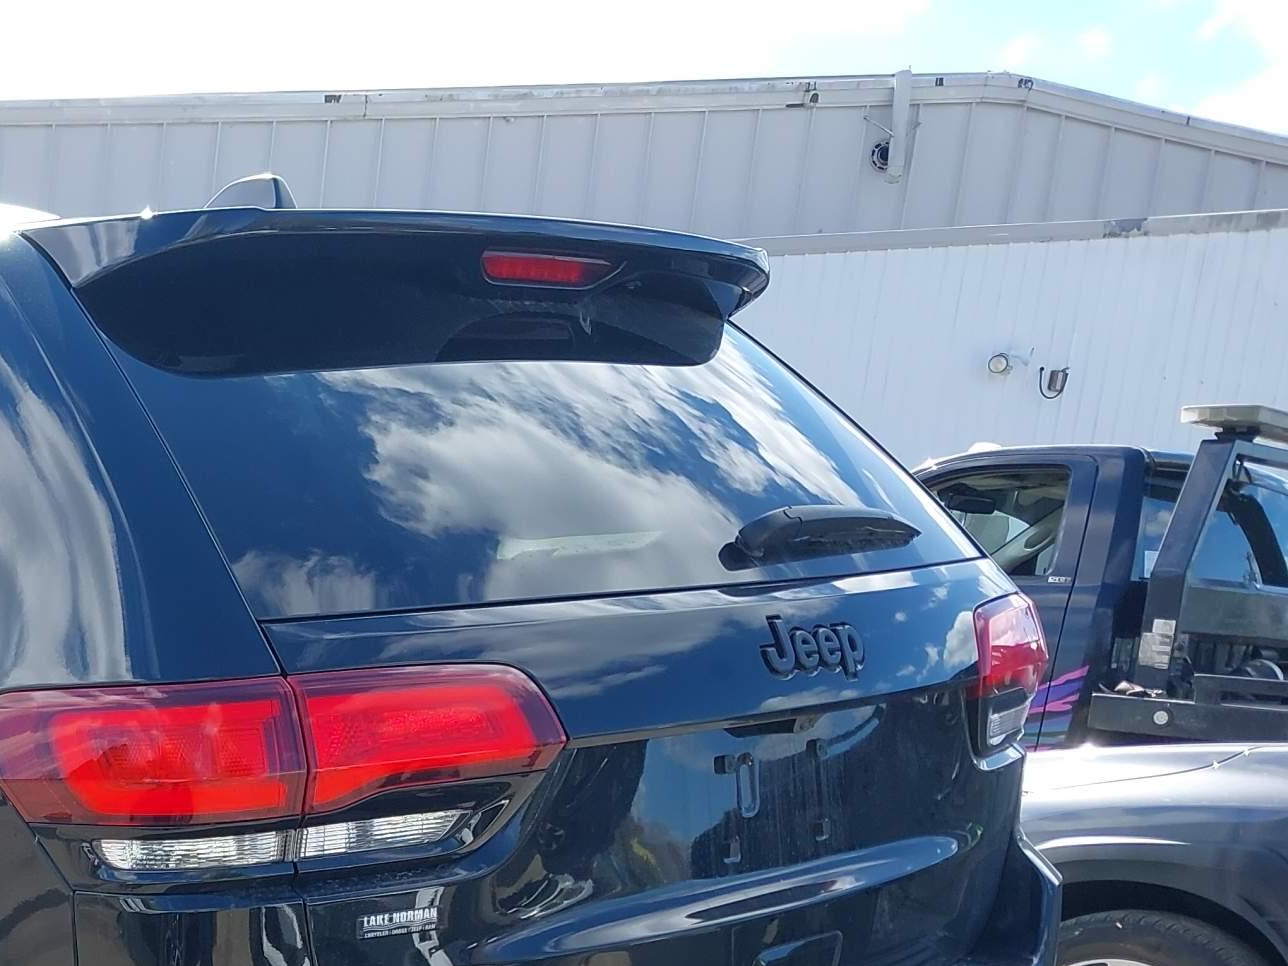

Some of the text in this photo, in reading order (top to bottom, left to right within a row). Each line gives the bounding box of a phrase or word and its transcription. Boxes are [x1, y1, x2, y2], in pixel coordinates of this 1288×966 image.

[760, 614, 865, 681] Jeep
[364, 907, 437, 927] LAKE NORMAN
